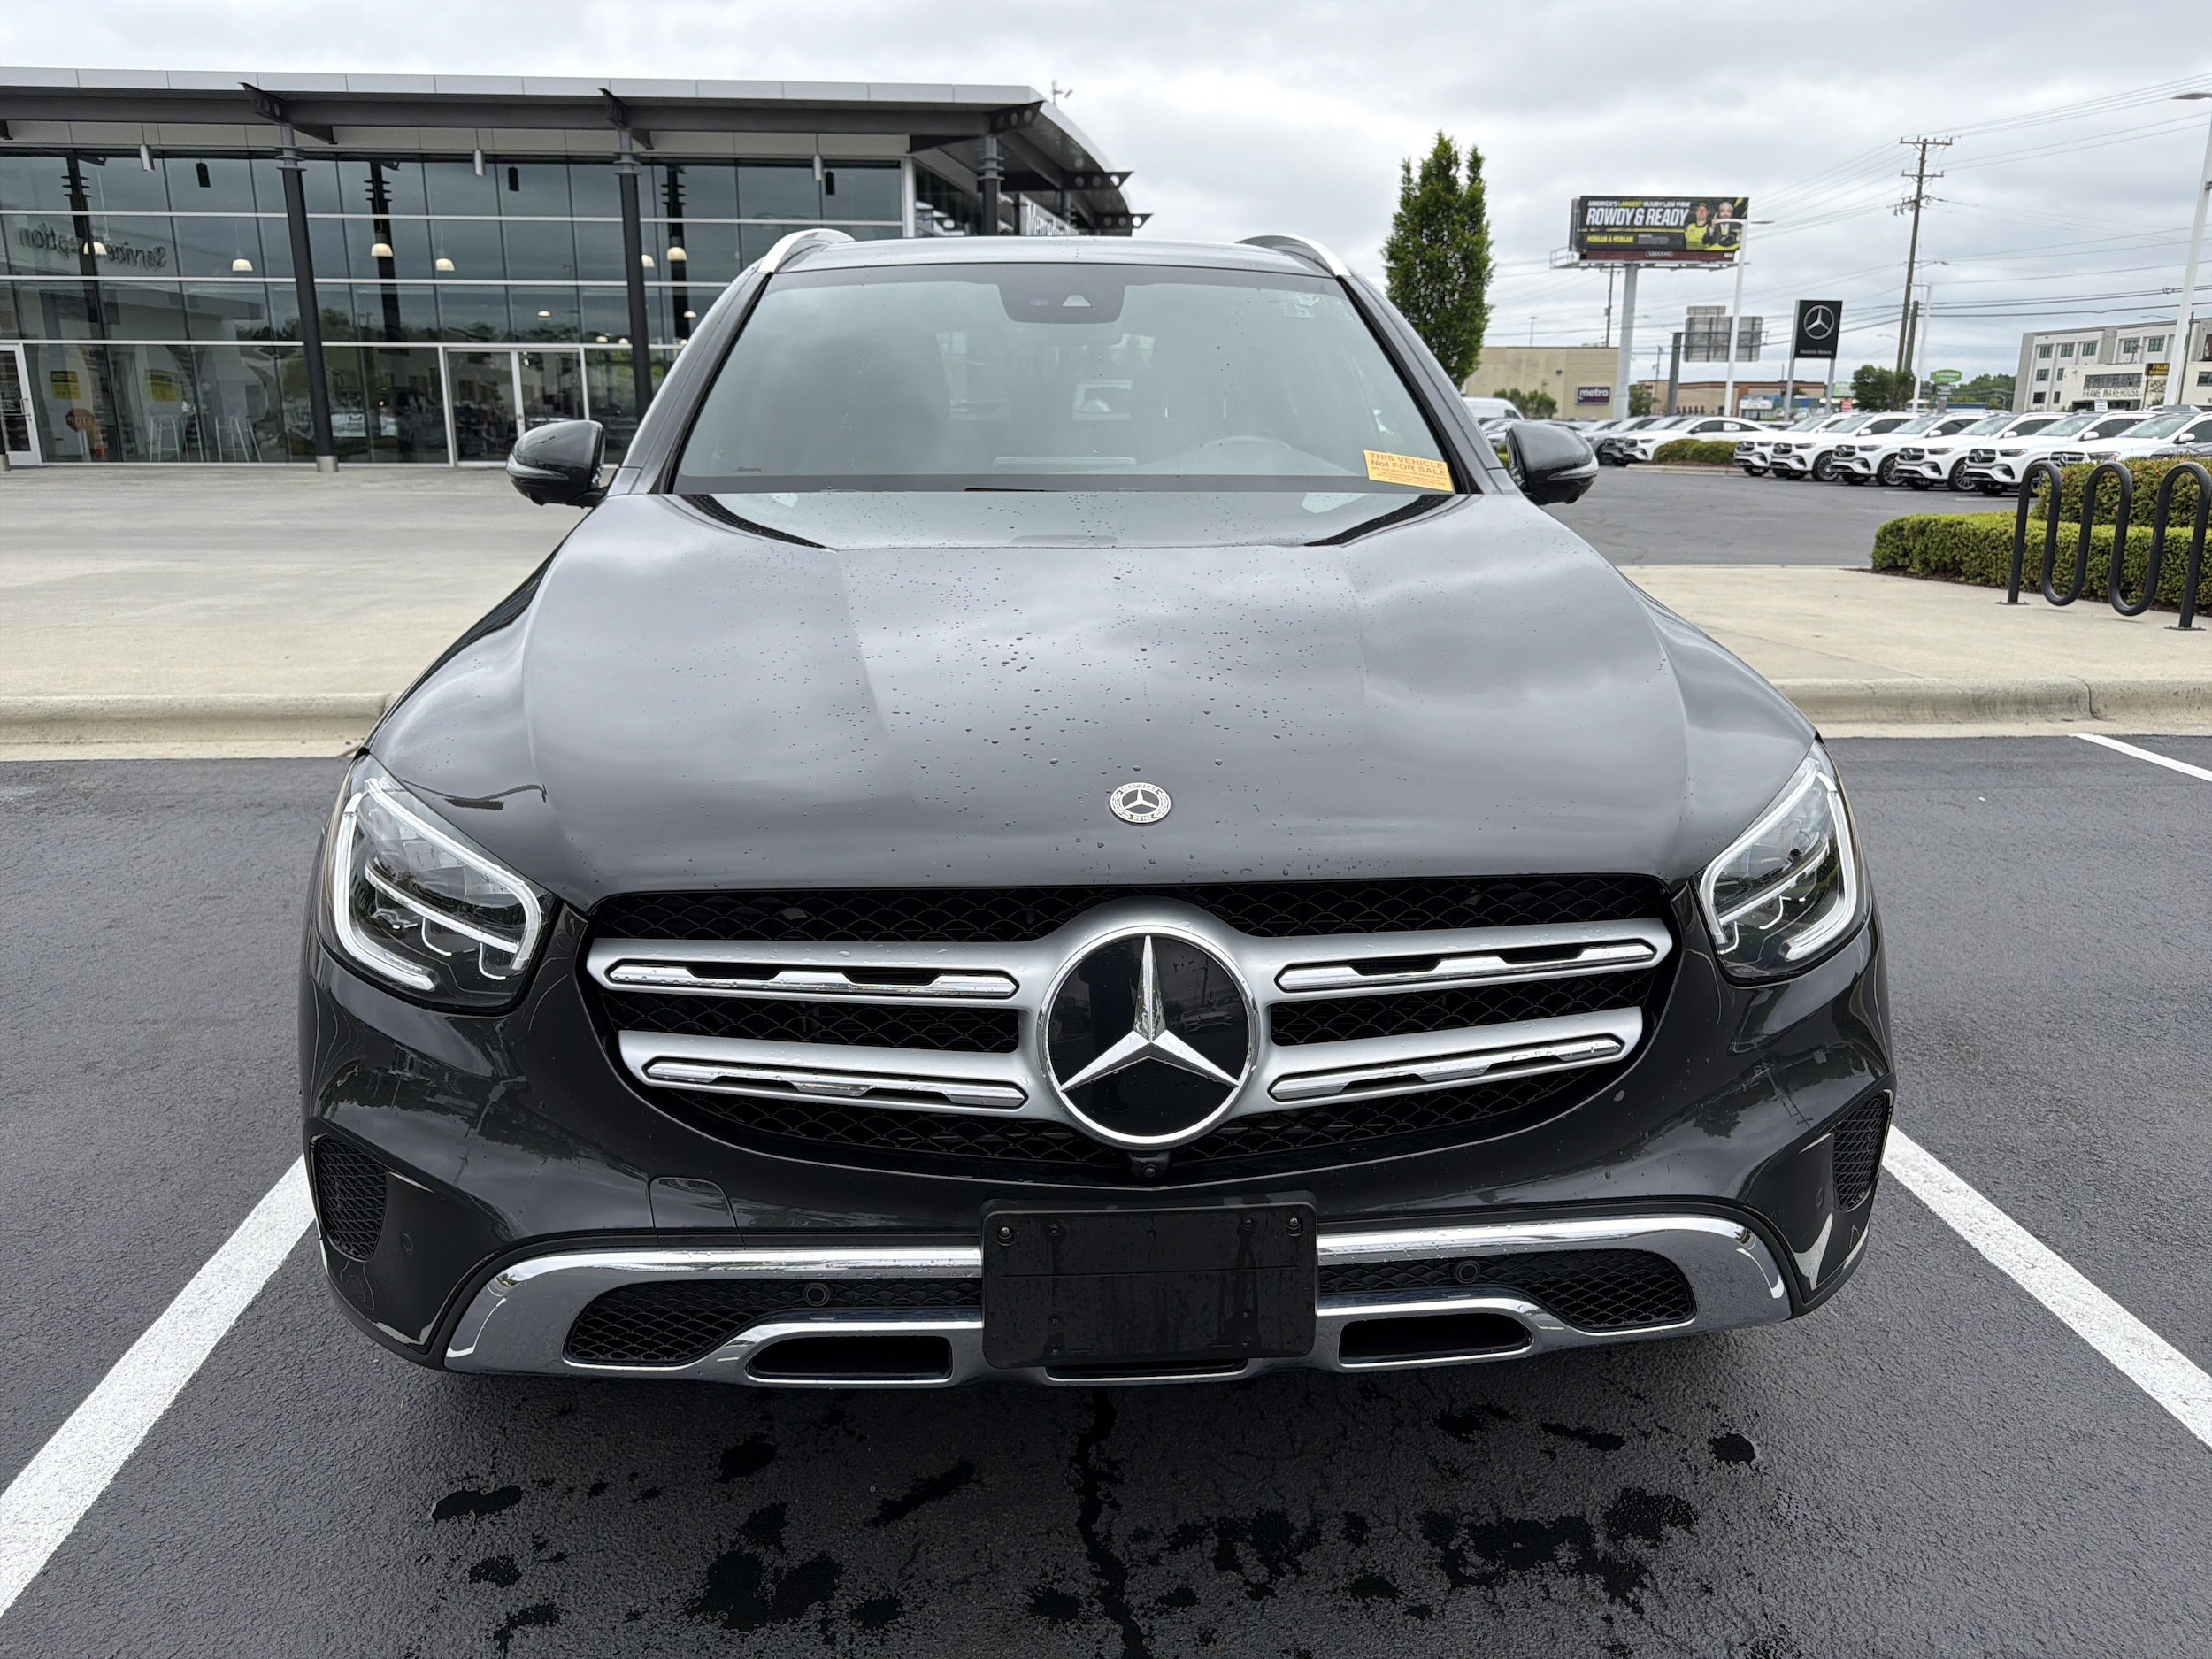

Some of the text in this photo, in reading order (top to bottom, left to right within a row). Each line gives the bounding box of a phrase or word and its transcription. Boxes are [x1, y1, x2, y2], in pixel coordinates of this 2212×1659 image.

[1586, 207, 1690, 227] ROWDY & READY
[1578, 388, 1609, 400] metro
[2082, 387, 2139, 398] FRAME WAREHOUSE
[1370, 452, 1444, 470] THIS VEHICLE
[1371, 459, 1448, 476] Not FOR SALE
